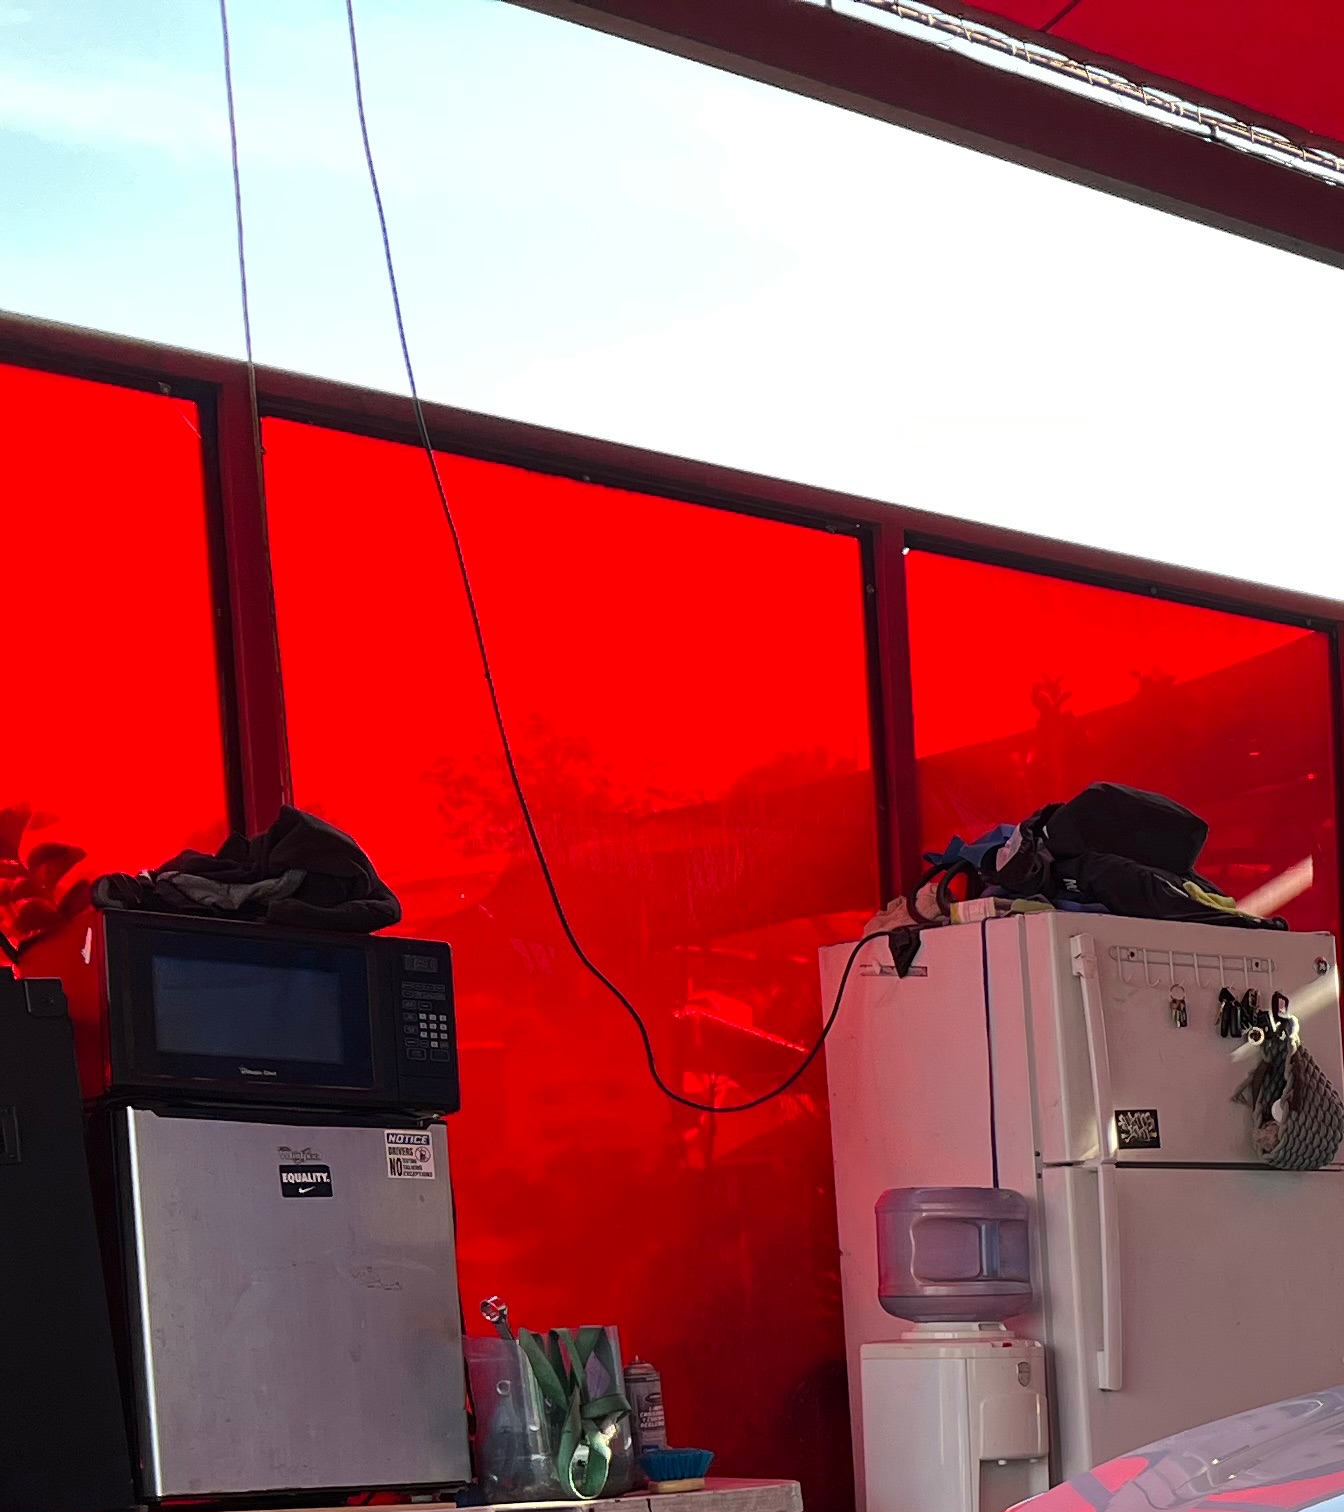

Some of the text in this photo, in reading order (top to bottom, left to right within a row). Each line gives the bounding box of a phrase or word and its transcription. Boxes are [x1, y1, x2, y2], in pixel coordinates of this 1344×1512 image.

[388, 1133, 428, 1144] NOTICE
[388, 1146, 413, 1156] DRIVERS
[389, 1157, 403, 1177] NO
